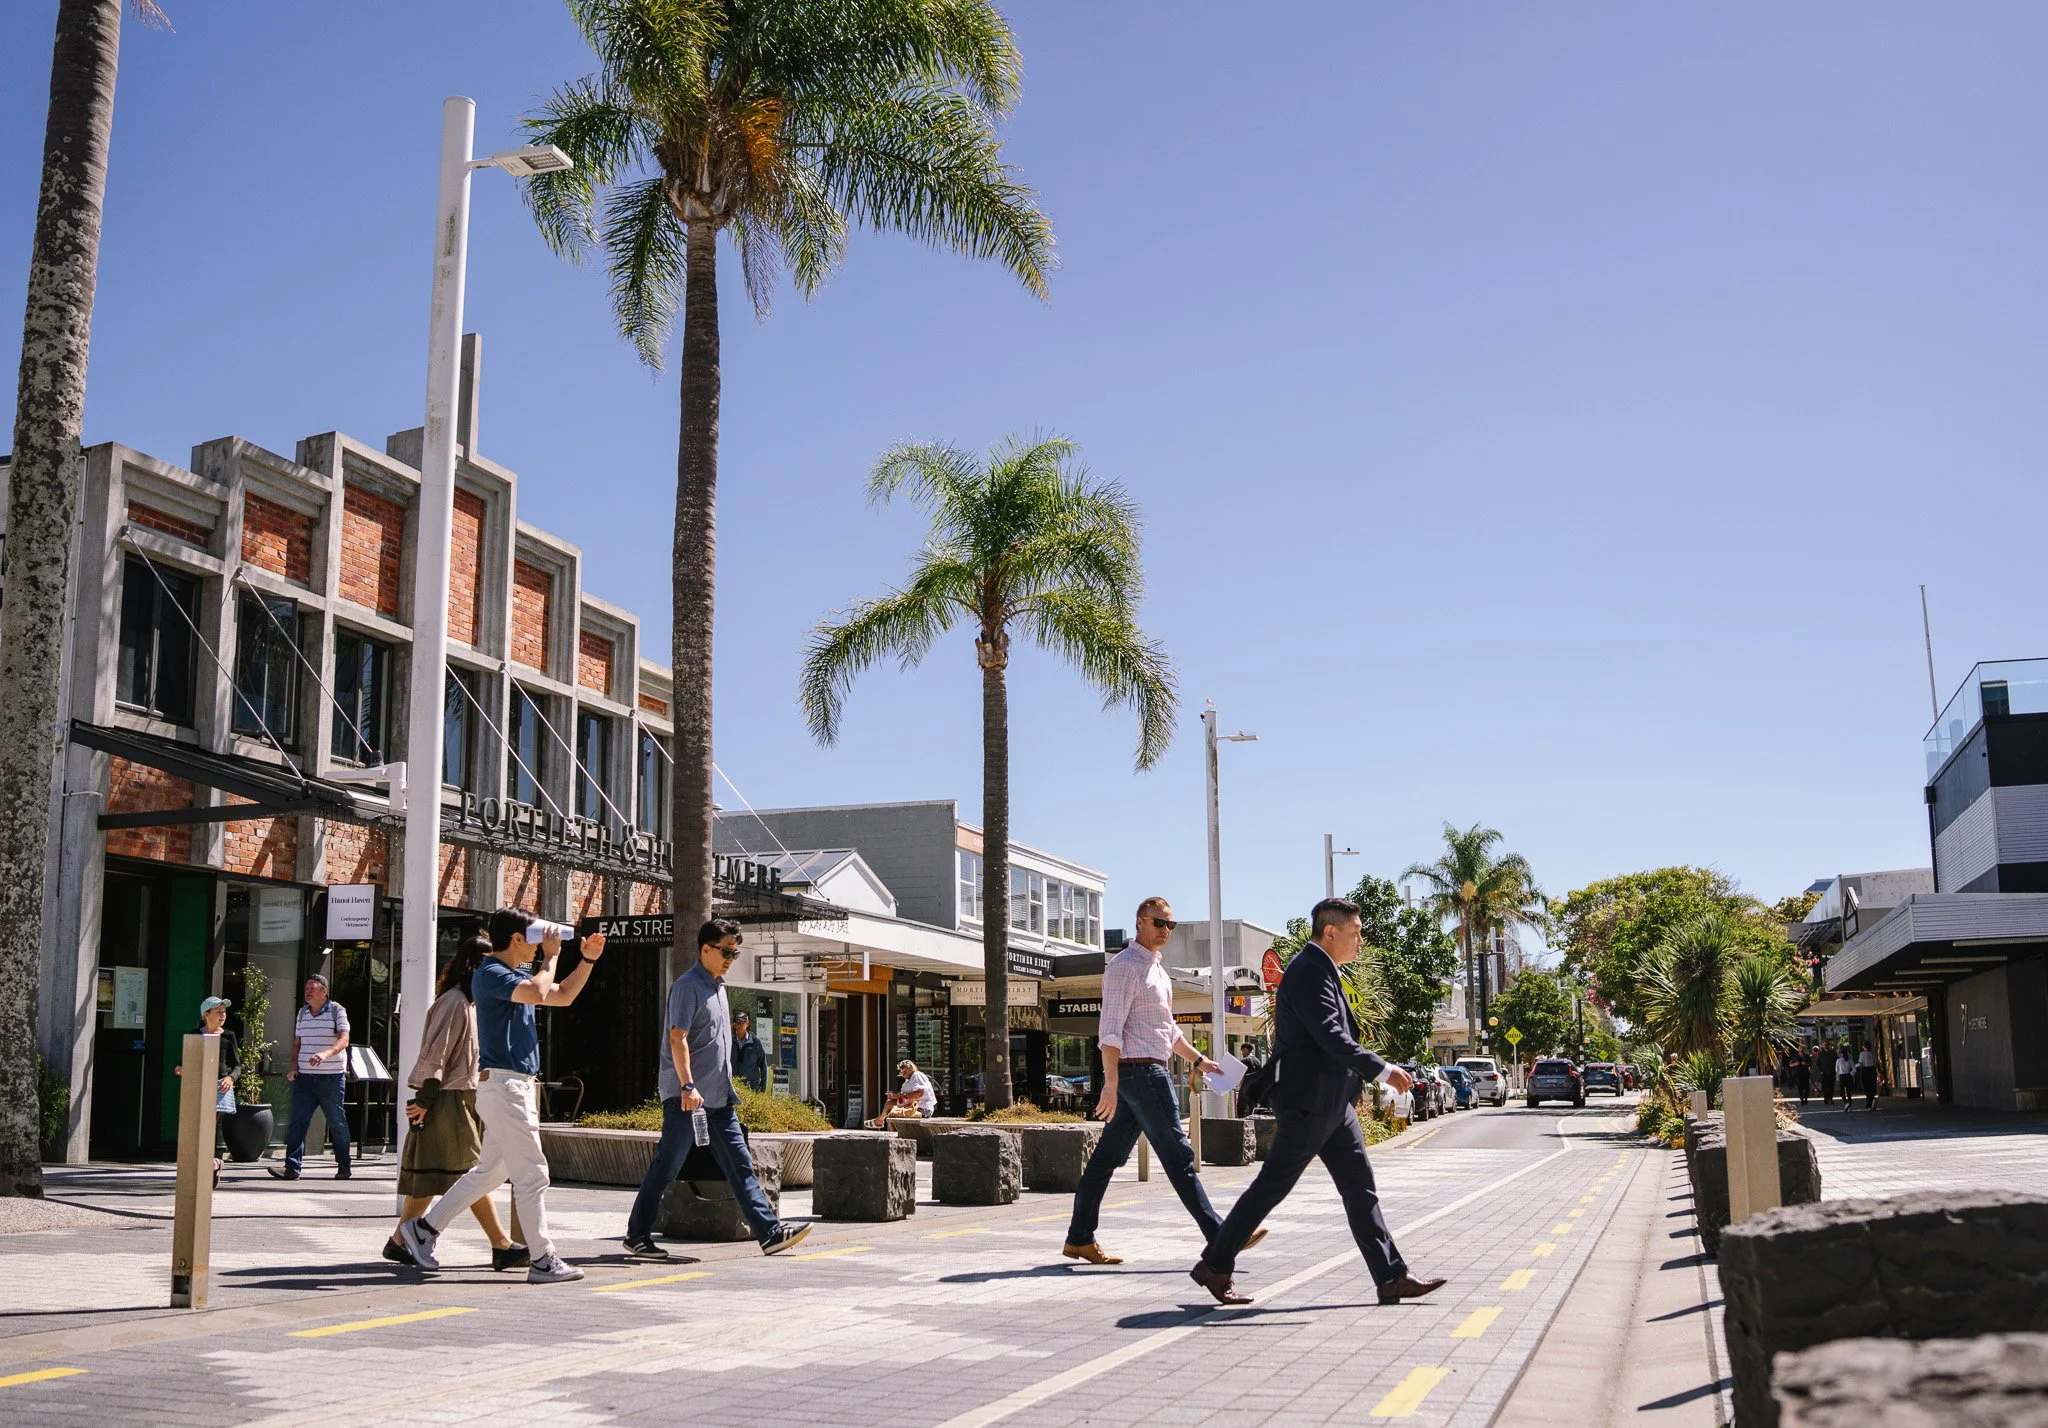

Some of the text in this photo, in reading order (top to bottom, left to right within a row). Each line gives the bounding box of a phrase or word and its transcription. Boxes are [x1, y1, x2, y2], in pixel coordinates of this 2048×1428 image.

[461, 791, 615, 857] FORTIETH
[621, 822, 638, 862] &
[599, 921, 628, 937] EAT
[1034, 957, 1051, 969] HIRST
